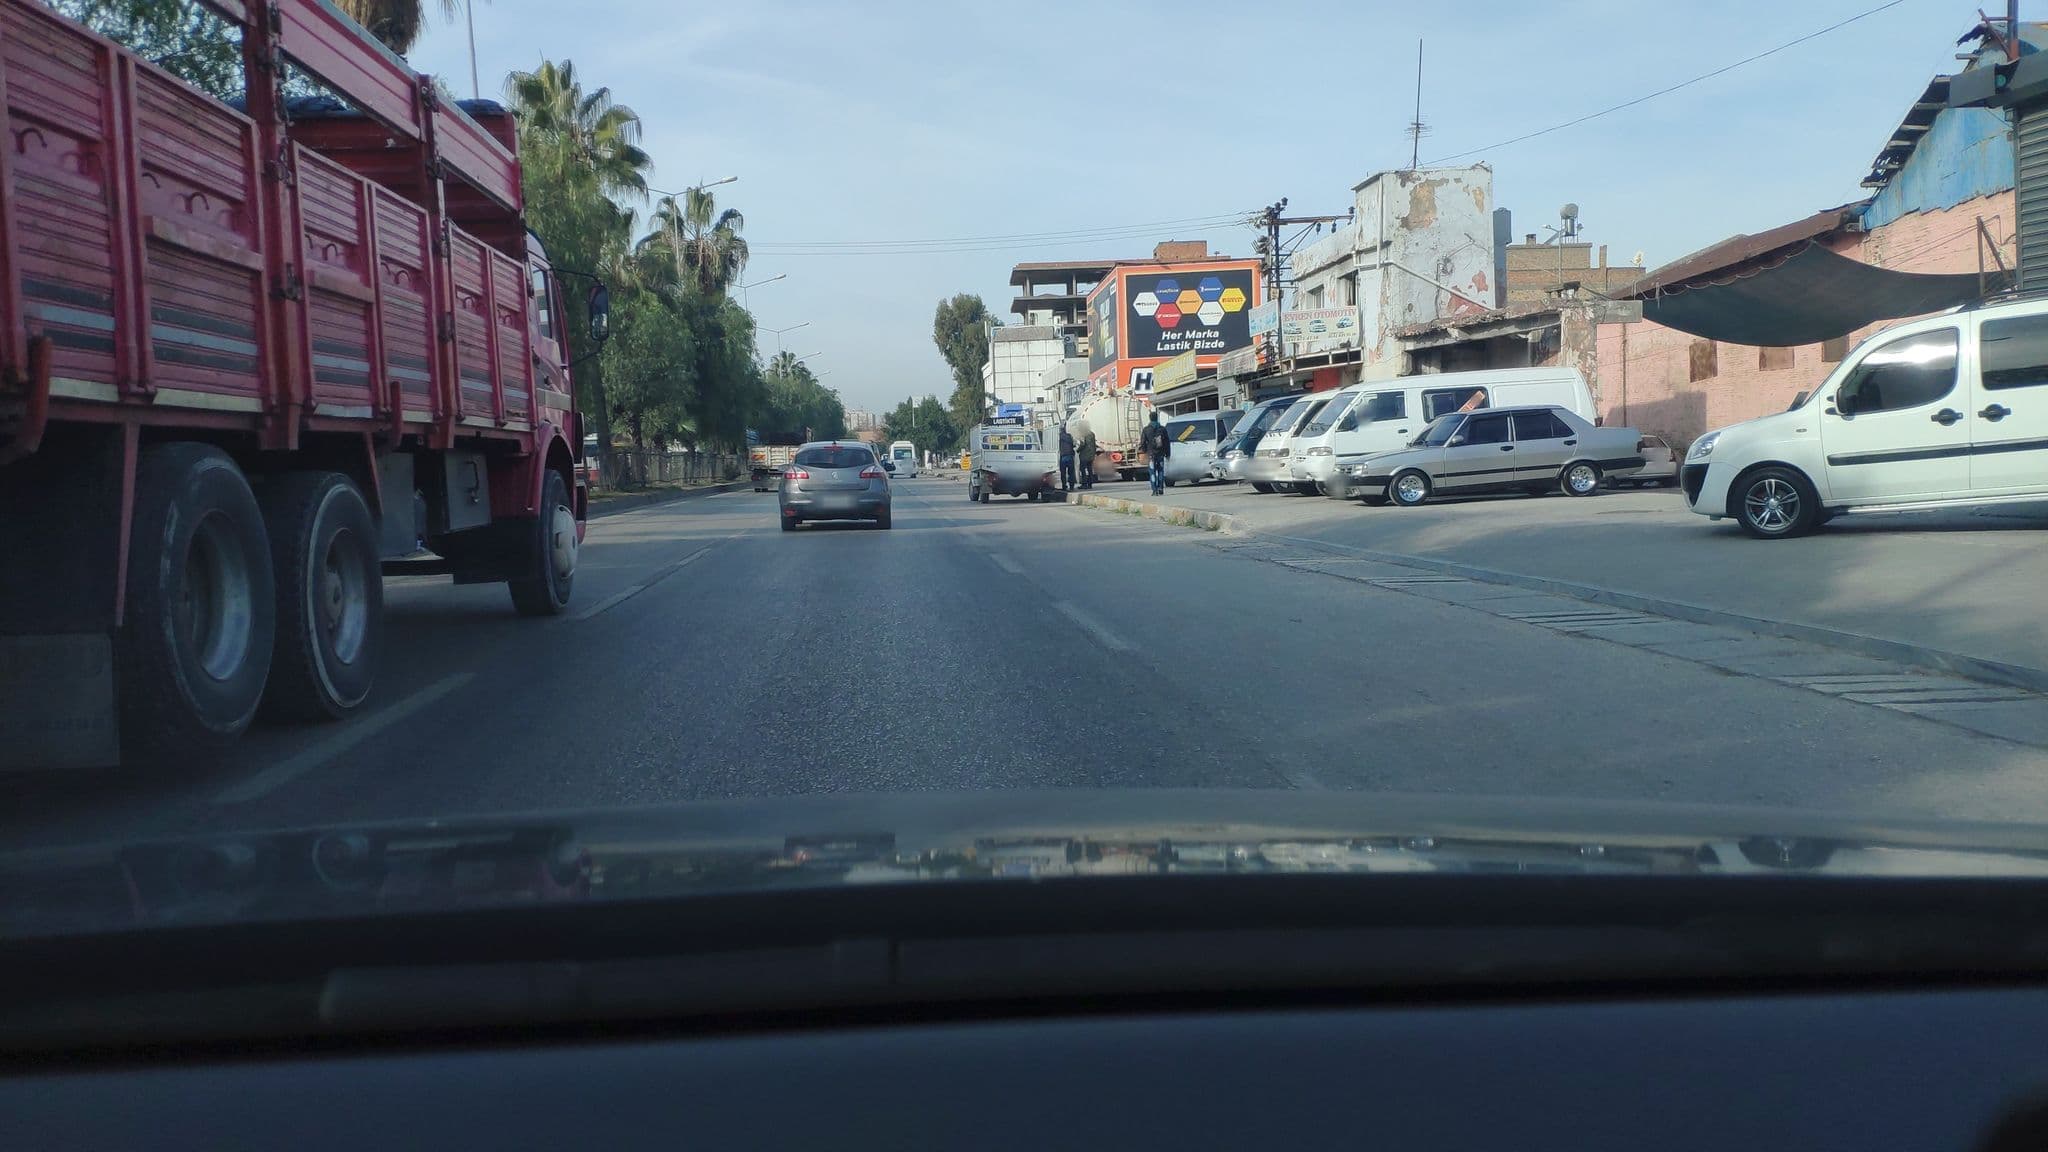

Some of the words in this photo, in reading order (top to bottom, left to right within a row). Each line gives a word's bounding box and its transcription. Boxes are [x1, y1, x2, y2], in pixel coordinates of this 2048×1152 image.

[1161, 331, 1183, 340] Her
[1185, 329, 1219, 339] Marka
[1156, 341, 1191, 351] Lastik
[1193, 340, 1225, 350] Bizde
[1135, 372, 1154, 391] H
